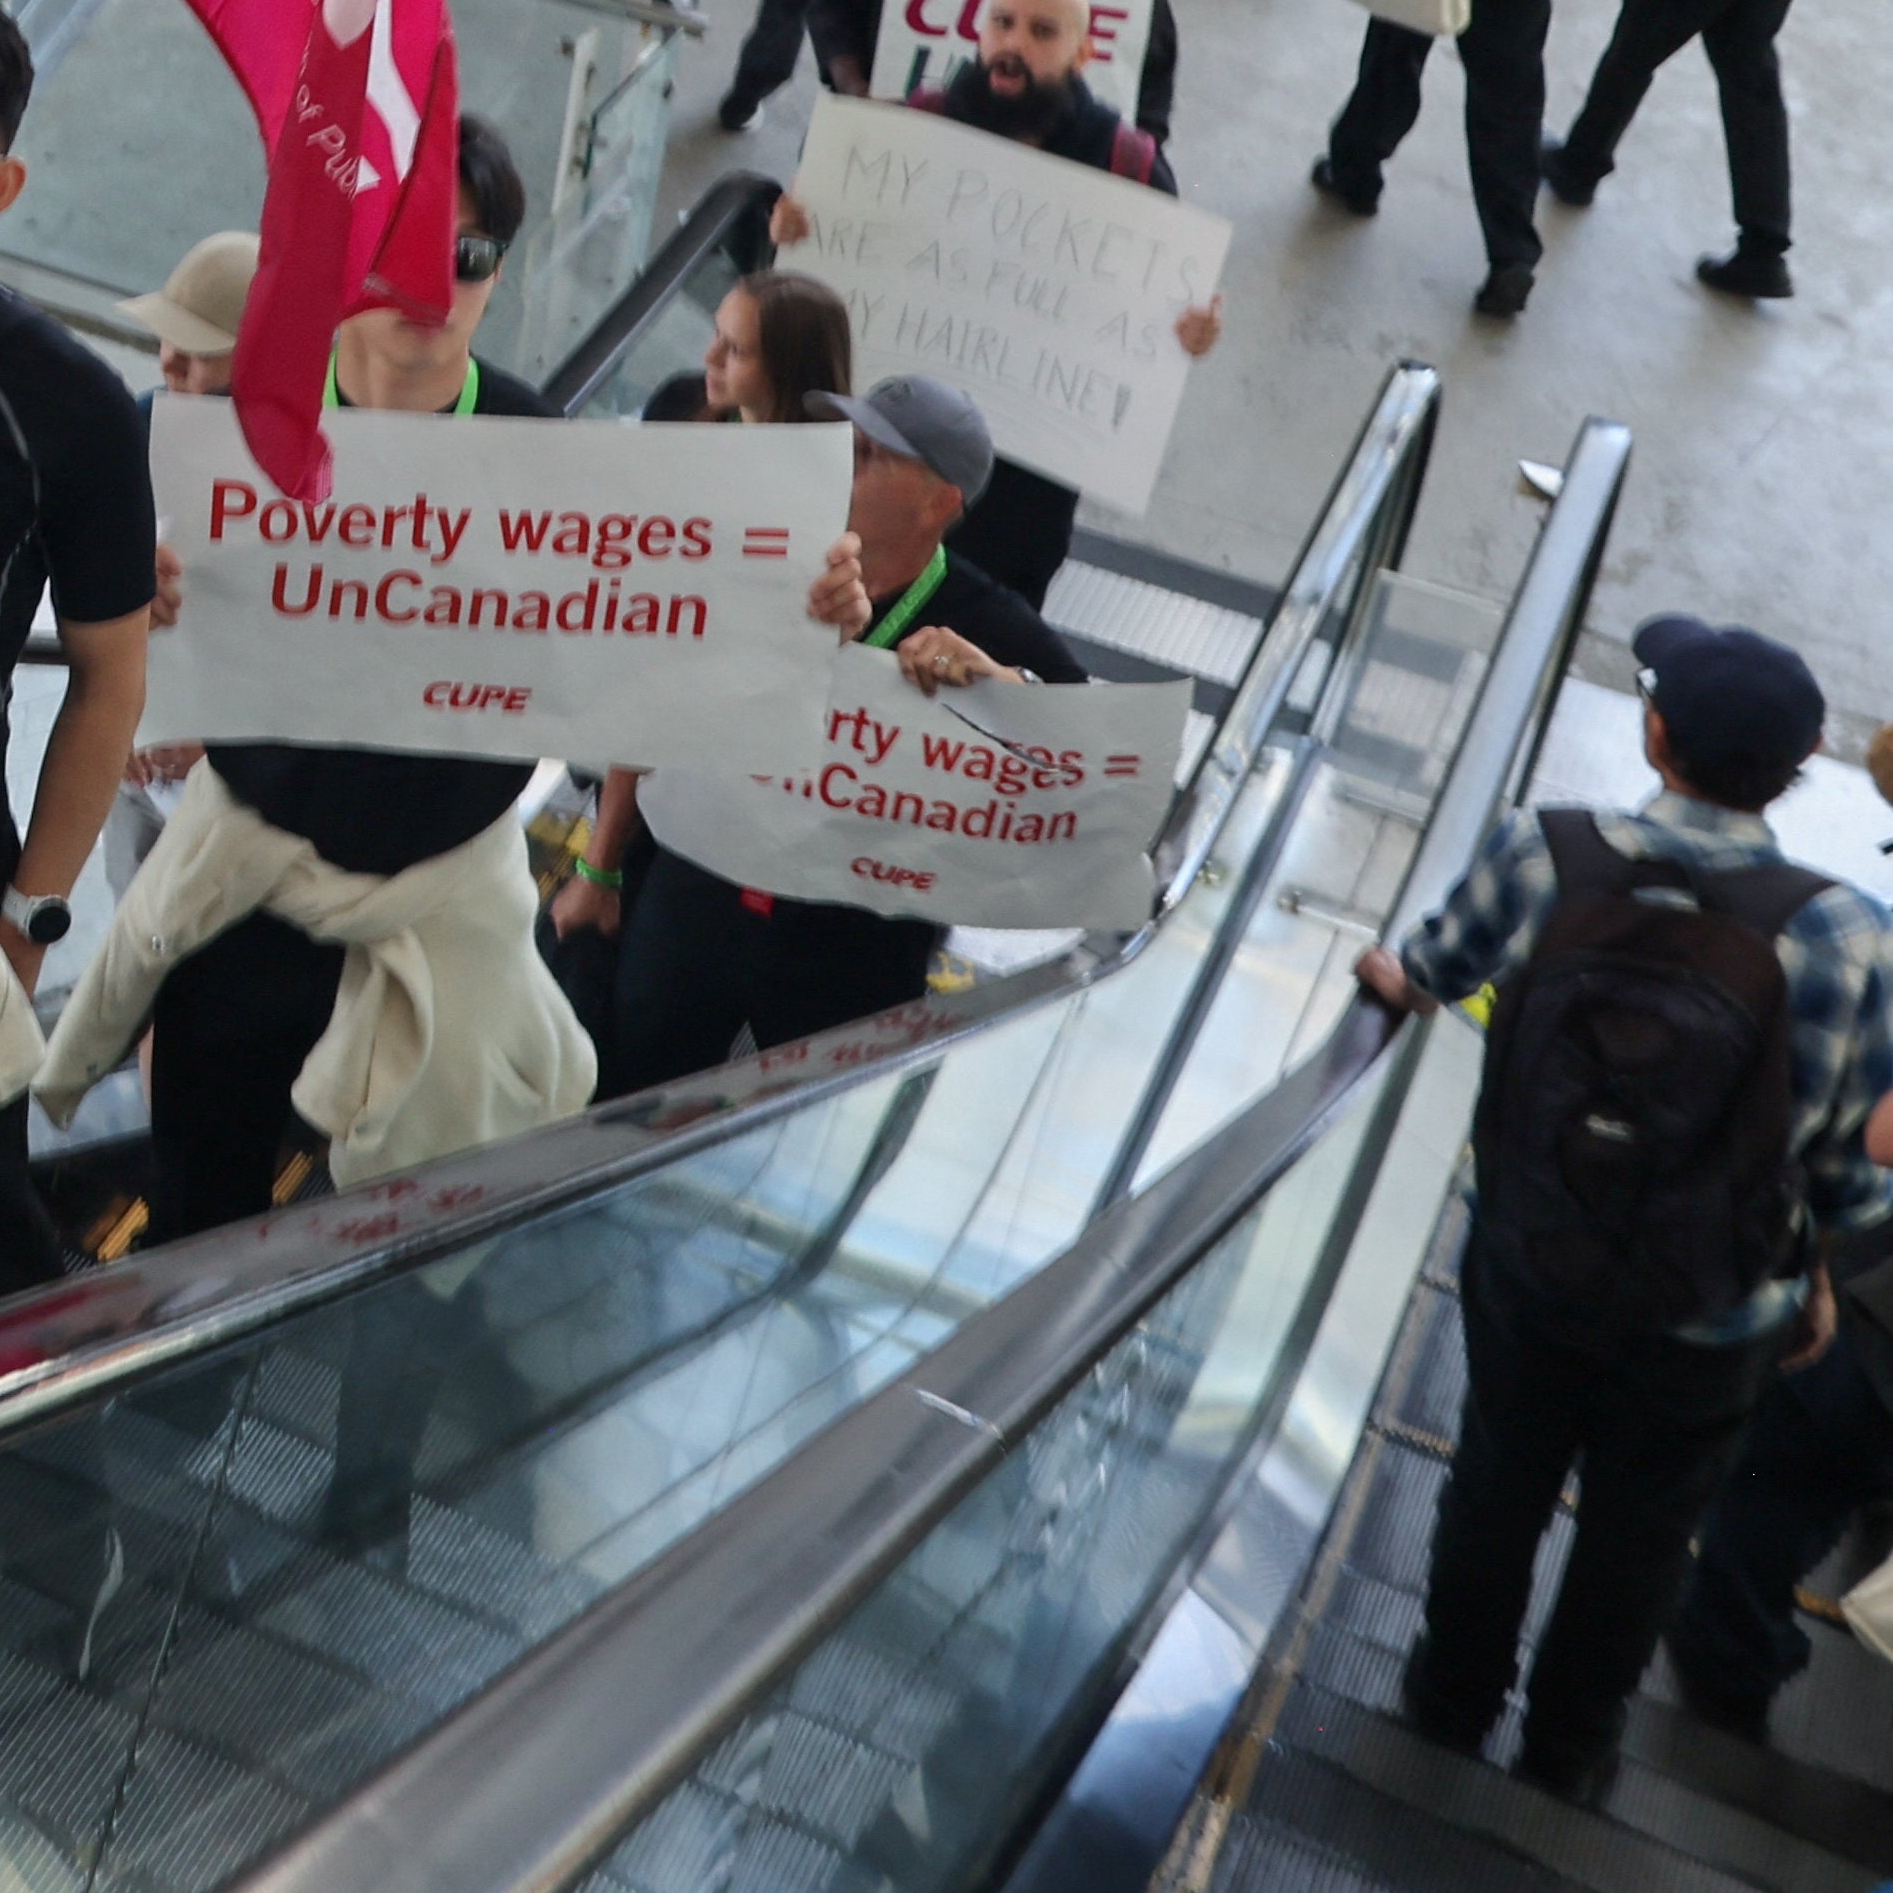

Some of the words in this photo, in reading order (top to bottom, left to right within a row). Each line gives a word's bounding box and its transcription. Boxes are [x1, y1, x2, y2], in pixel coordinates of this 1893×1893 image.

[843, 142, 930, 208] MY
[947, 166, 1204, 308] POCKETS
[905, 238, 969, 286] AS
[208, 478, 474, 564] Poverty
[495, 508, 715, 569] wages
[741, 526, 790, 558] =
[268, 562, 711, 641] UnCanadian
[420, 680, 532, 715] CUPE
[919, 732, 1087, 798] wages
[1103, 753, 1141, 777] =
[849, 855, 938, 893] CUPE
